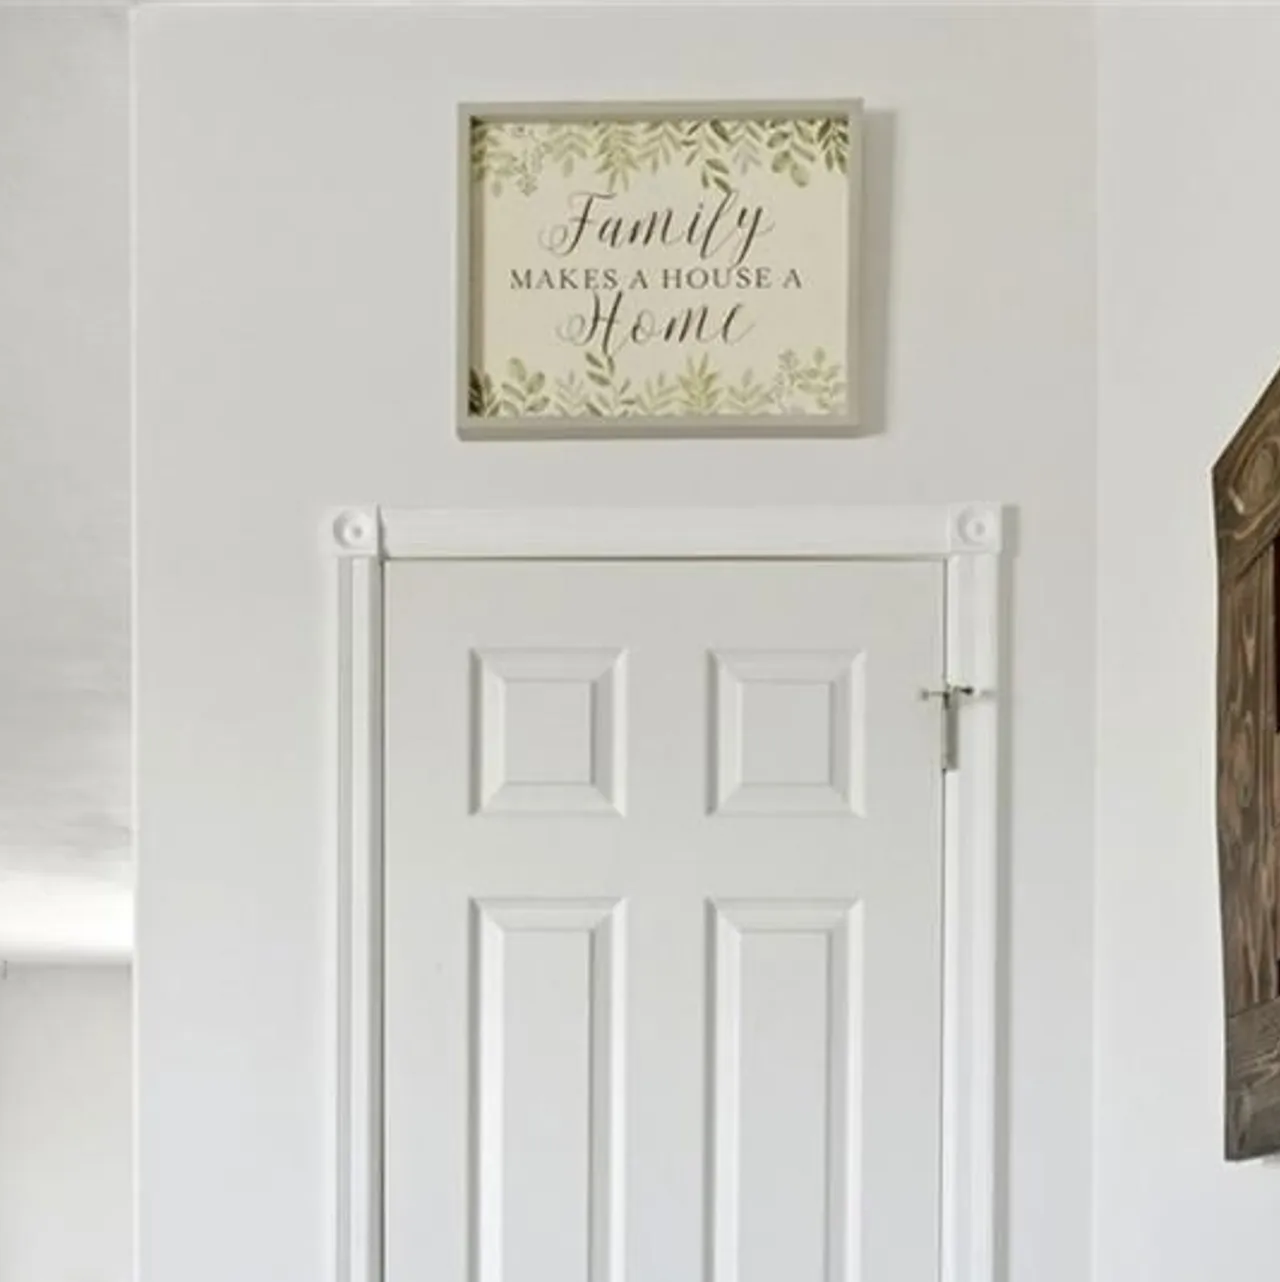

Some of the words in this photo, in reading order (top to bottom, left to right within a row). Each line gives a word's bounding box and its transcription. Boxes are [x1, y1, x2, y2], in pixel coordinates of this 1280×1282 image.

[540, 189, 775, 267] Family
[510, 268, 618, 290] MAKES
[629, 268, 649, 290] A
[662, 267, 771, 290] HOUSE
[783, 268, 803, 290] A
[558, 291, 755, 355] Home
